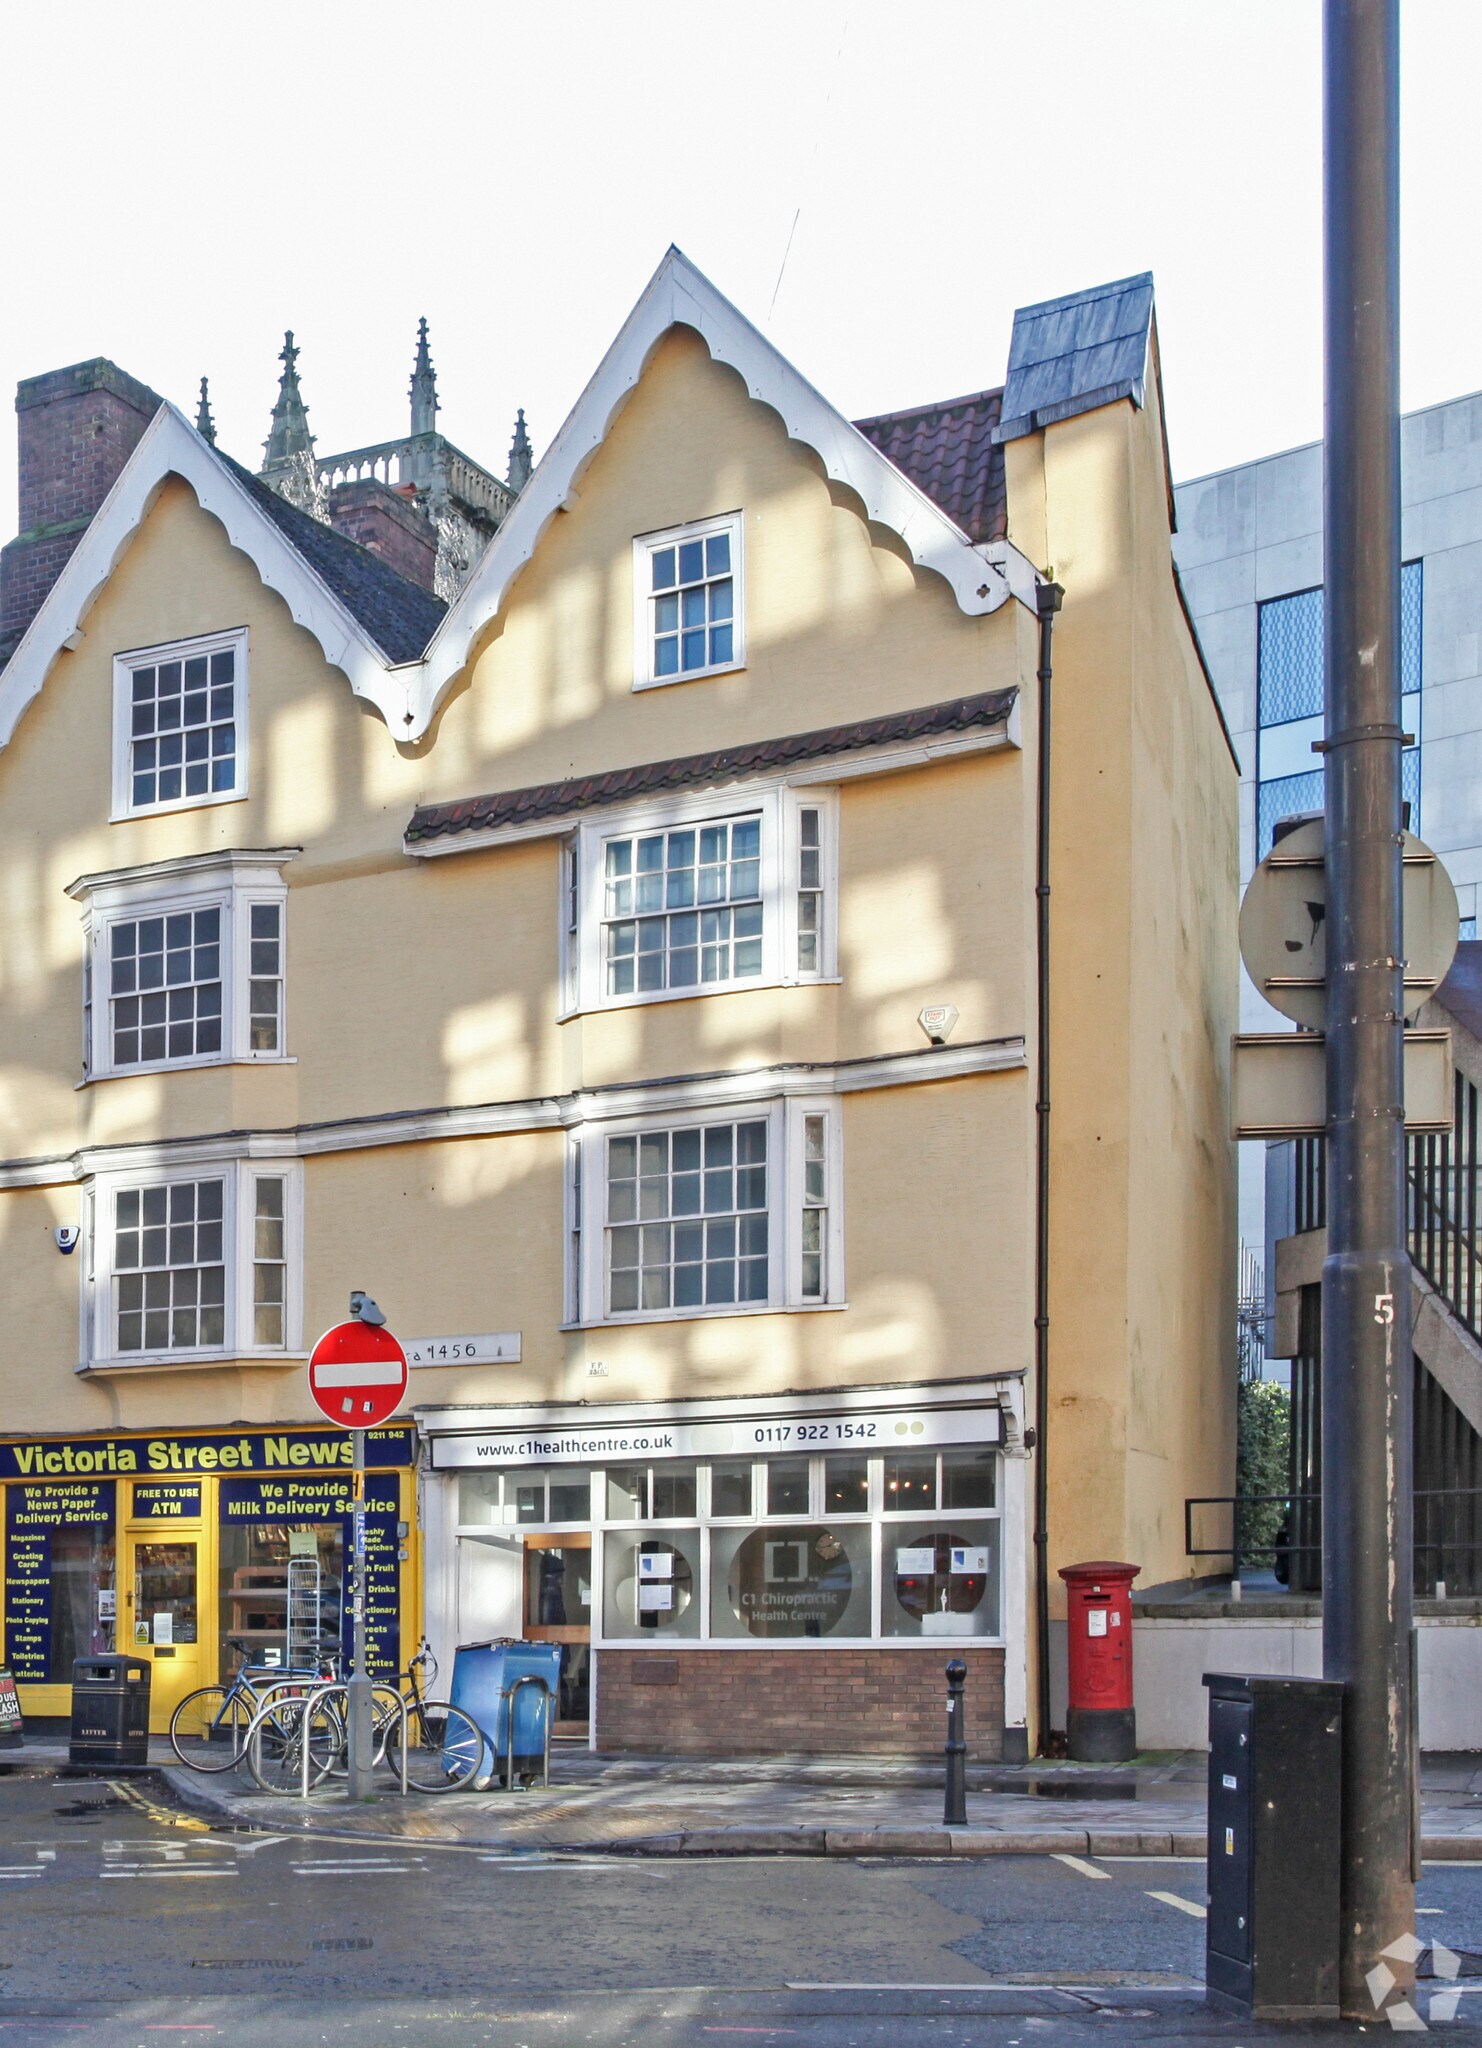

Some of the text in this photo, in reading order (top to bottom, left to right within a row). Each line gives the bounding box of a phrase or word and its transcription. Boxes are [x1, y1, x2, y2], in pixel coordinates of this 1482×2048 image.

[1374, 1294, 1394, 1324] 5
[428, 1343, 476, 1358] 1456
[368, 1431, 386, 1439] 9211
[388, 1430, 404, 1438] 942
[754, 1423, 876, 1442] 0117 922 1542
[476, 1434, 673, 1457] www.c1healthcentre.co.uk
[13, 1437, 354, 1473] Victoria Street News
[24, 1485, 99, 1498] We Provide a
[137, 1488, 198, 1498] FREE TO USE
[260, 1482, 348, 1498] We Provide
[27, 1499, 96, 1511] News Paper
[151, 1502, 182, 1514] ATM
[228, 1498, 396, 1516] Milk Delivery Sevice
[16, 1511, 108, 1525] Delivery Service
[364, 1528, 385, 1536] eshly
[10, 1534, 46, 1542] Magazines
[348, 1544, 394, 1552] Swiches
[12, 1553, 44, 1561] Greeting
[374, 1564, 394, 1572] Fruit
[6, 1578, 50, 1586] Newspapers
[742, 1591, 838, 1608] C1 Chiropractic
[345, 1606, 396, 1614] Coctionary
[752, 1610, 827, 1621] Health Centre
[349, 1659, 394, 1667] Crettes
[4, 1692, 16, 1702] USE
